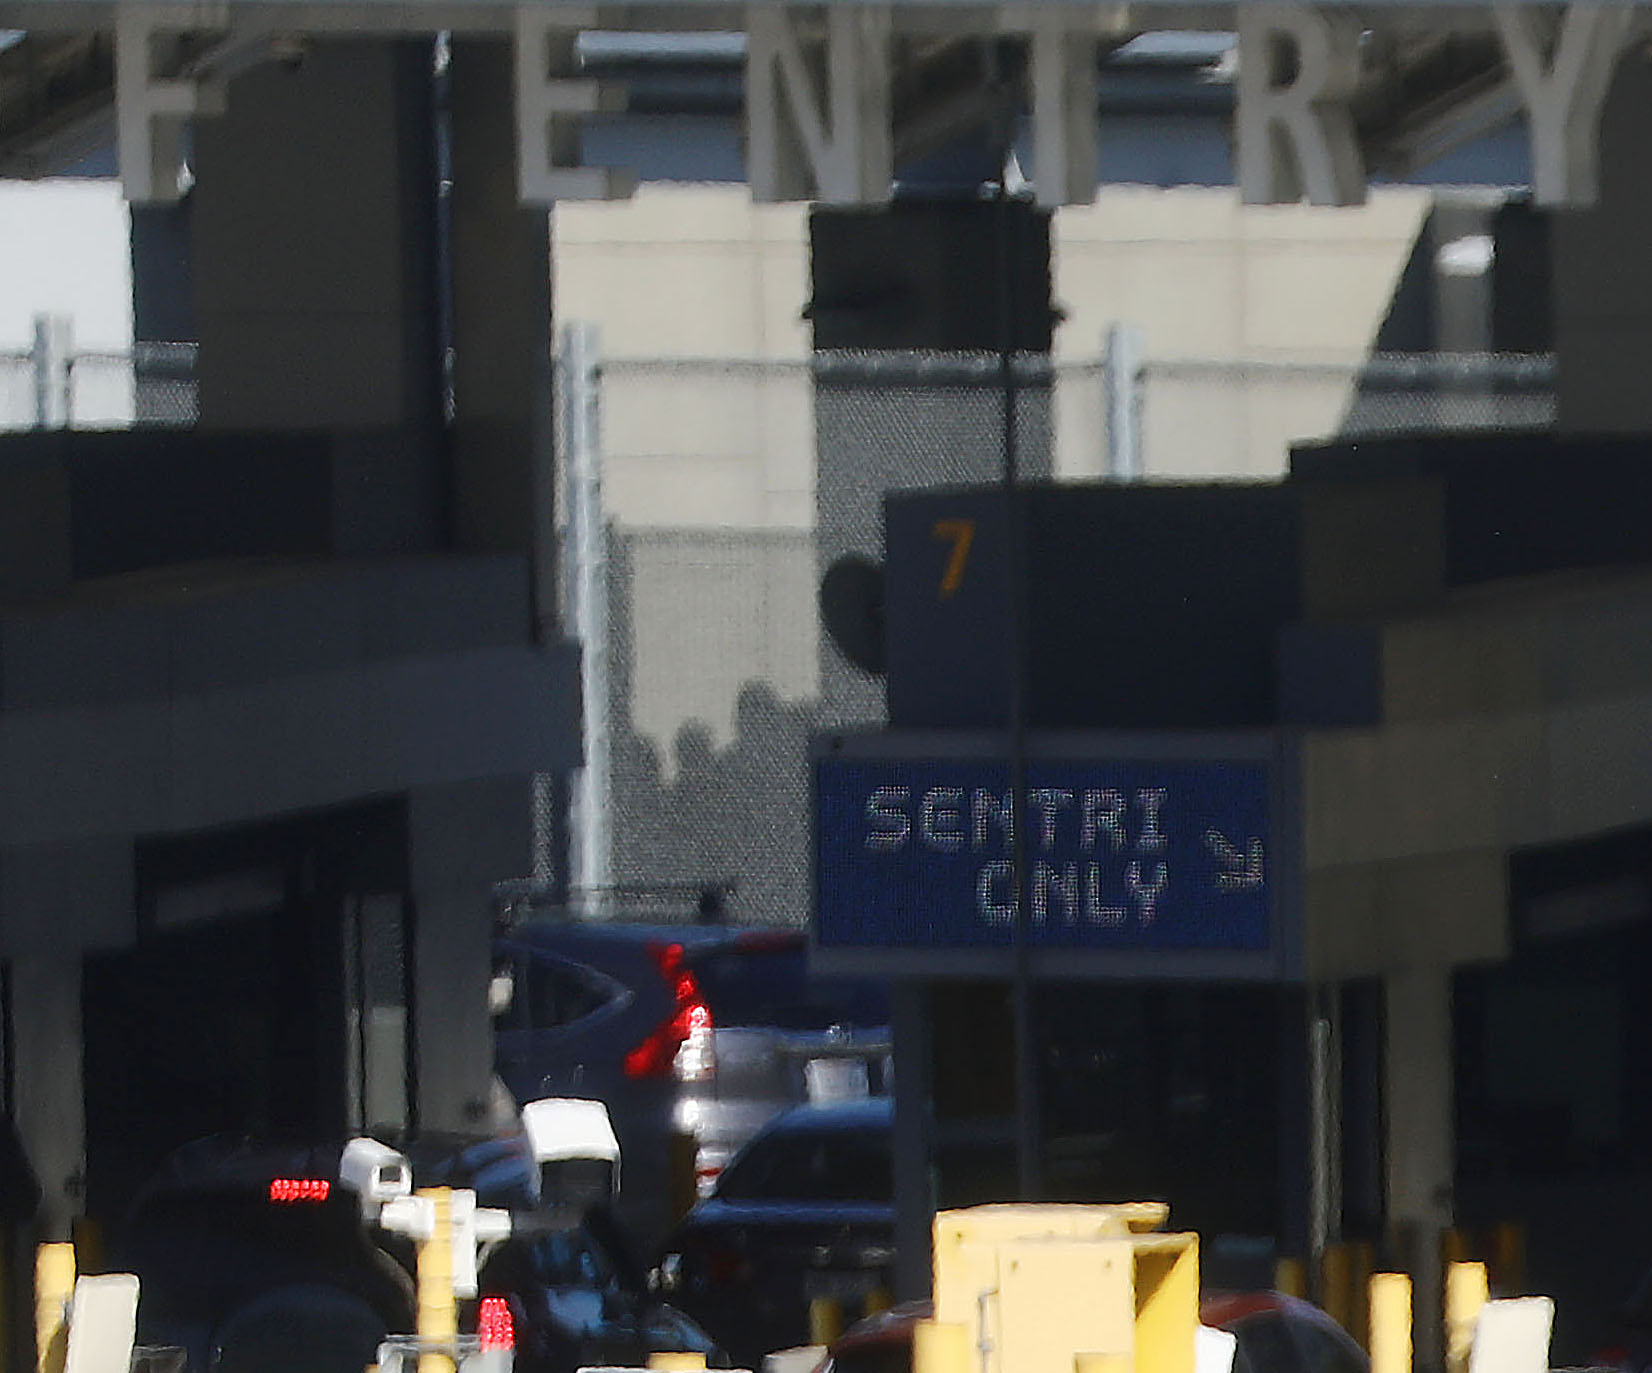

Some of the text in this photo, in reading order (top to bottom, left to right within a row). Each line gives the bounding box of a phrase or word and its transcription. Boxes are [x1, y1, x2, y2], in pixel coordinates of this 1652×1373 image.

[514, 0, 1640, 208] ENTRY
[932, 520, 974, 595] 7
[865, 785, 1170, 852] SENTRI
[975, 858, 1171, 928] ONLY
